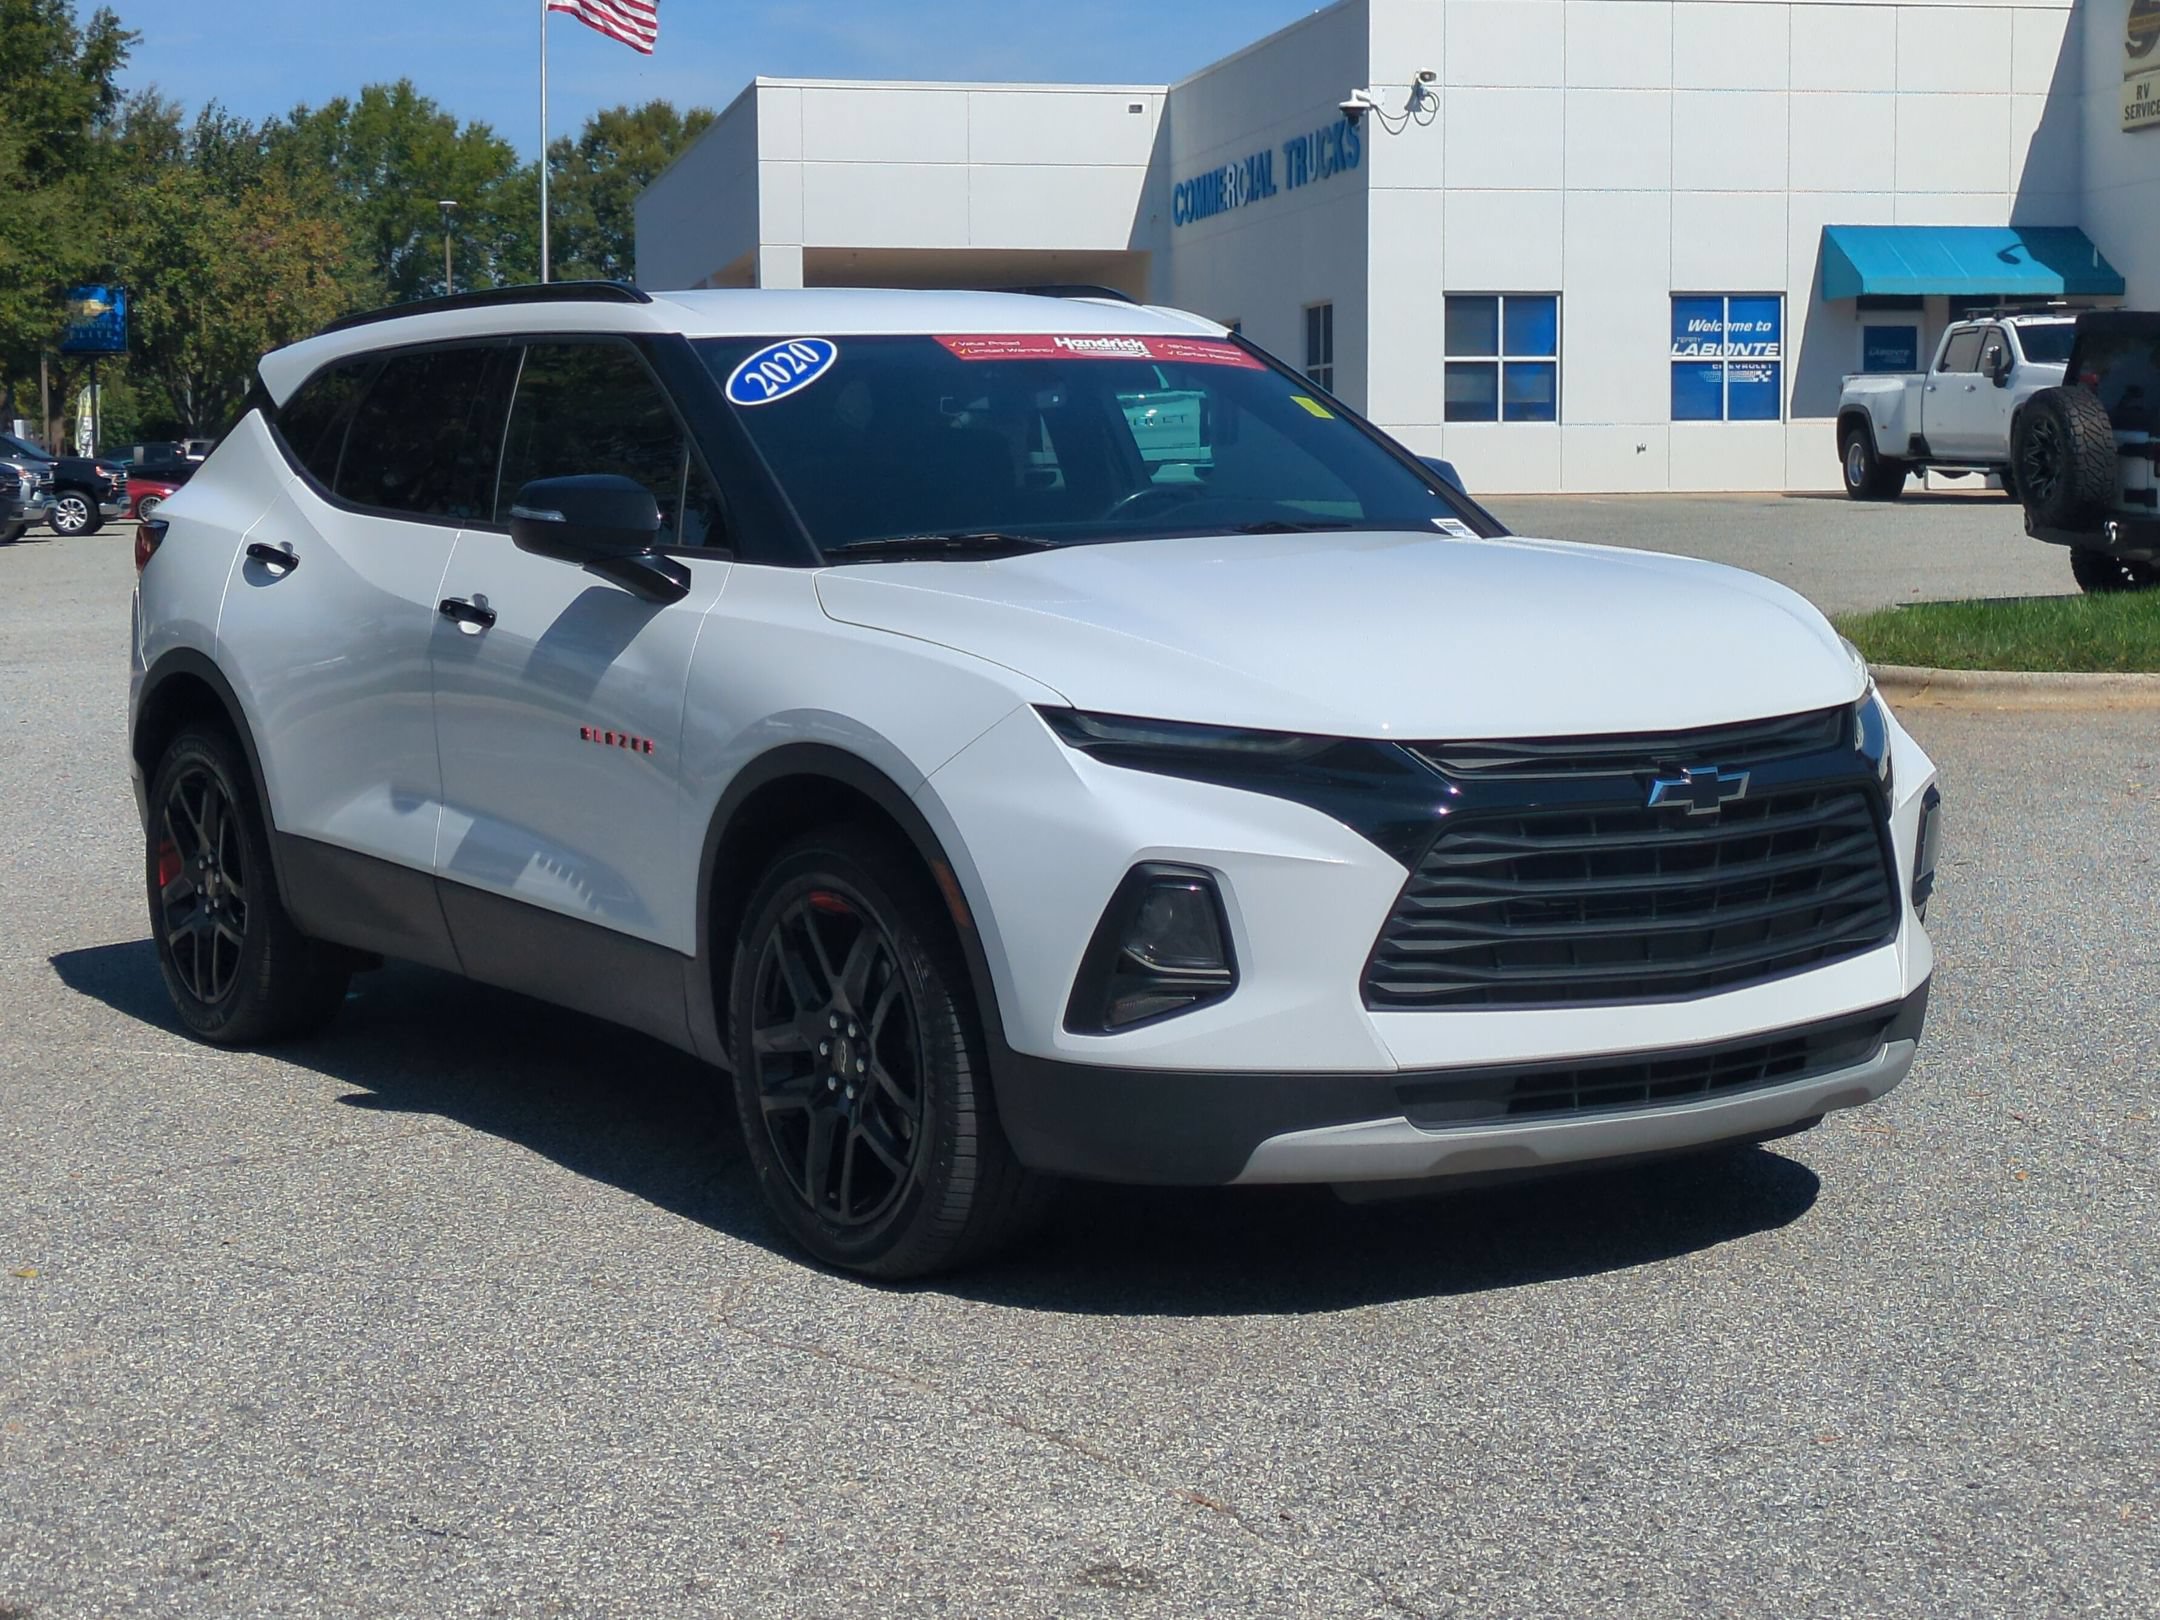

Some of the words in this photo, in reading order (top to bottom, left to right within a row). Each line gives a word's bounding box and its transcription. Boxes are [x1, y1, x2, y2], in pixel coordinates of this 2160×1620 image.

[2136, 82, 2150, 100] RV
[1173, 149, 1277, 227] COMMERCIAL
[1283, 119, 1361, 191] TRUCKS
[1688, 320, 1751, 331] Welcme
[1755, 321, 1771, 331] to
[1053, 336, 1148, 352] Hendrick
[1671, 342, 1779, 356] LABONTE
[745, 343, 820, 396] 2020
[580, 726, 655, 755] BLAZER
